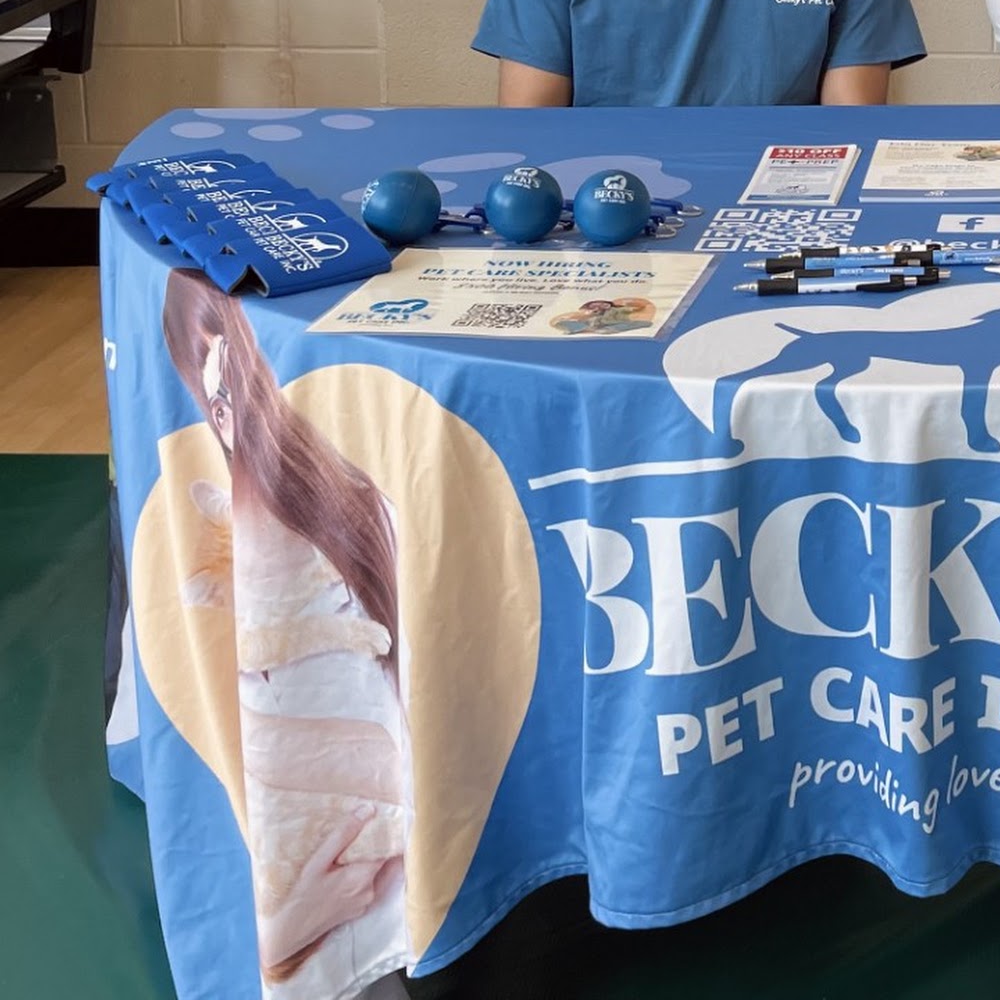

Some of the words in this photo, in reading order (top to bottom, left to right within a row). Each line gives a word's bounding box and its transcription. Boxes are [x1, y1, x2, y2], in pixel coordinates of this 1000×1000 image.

[253, 237, 271, 247] PET
[263, 246, 286, 260] CARE
[280, 260, 297, 275] INC
[265, 234, 314, 271] BECKY'S
[526, 270, 656, 278] SPECIALISTS
[657, 676, 783, 776] PET
[810, 667, 956, 755] CARE
[789, 757, 939, 834] providing
